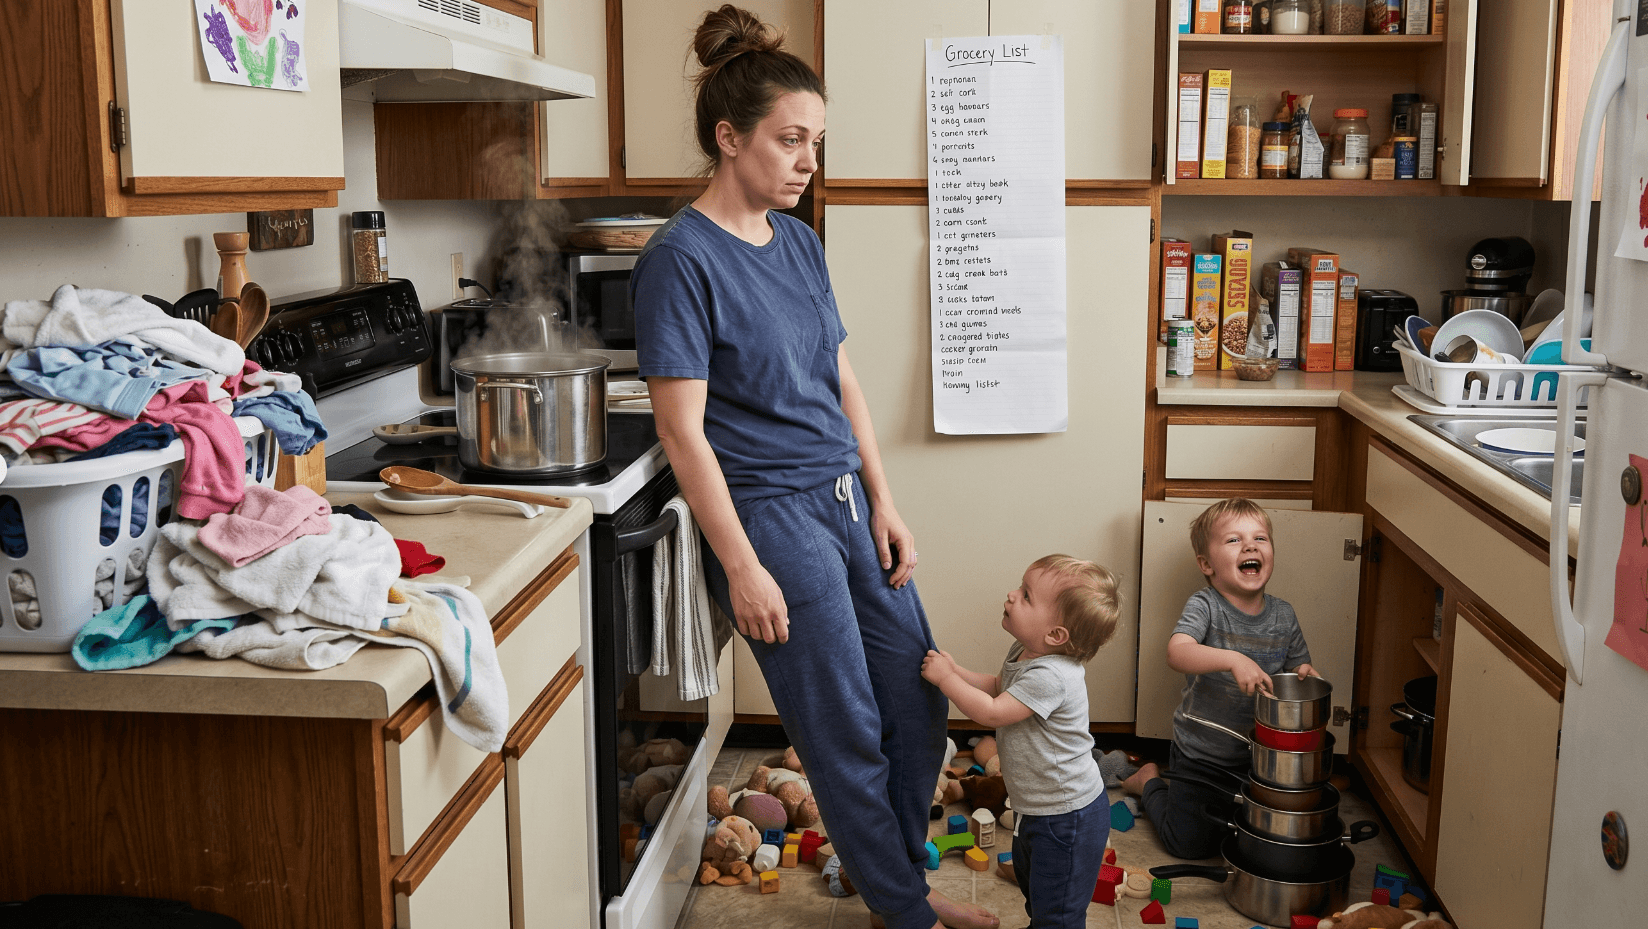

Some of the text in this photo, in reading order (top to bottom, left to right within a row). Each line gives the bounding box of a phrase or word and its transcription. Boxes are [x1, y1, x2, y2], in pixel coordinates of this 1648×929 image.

[945, 44, 1029, 66] Grocery List
[941, 105, 954, 114] egg
